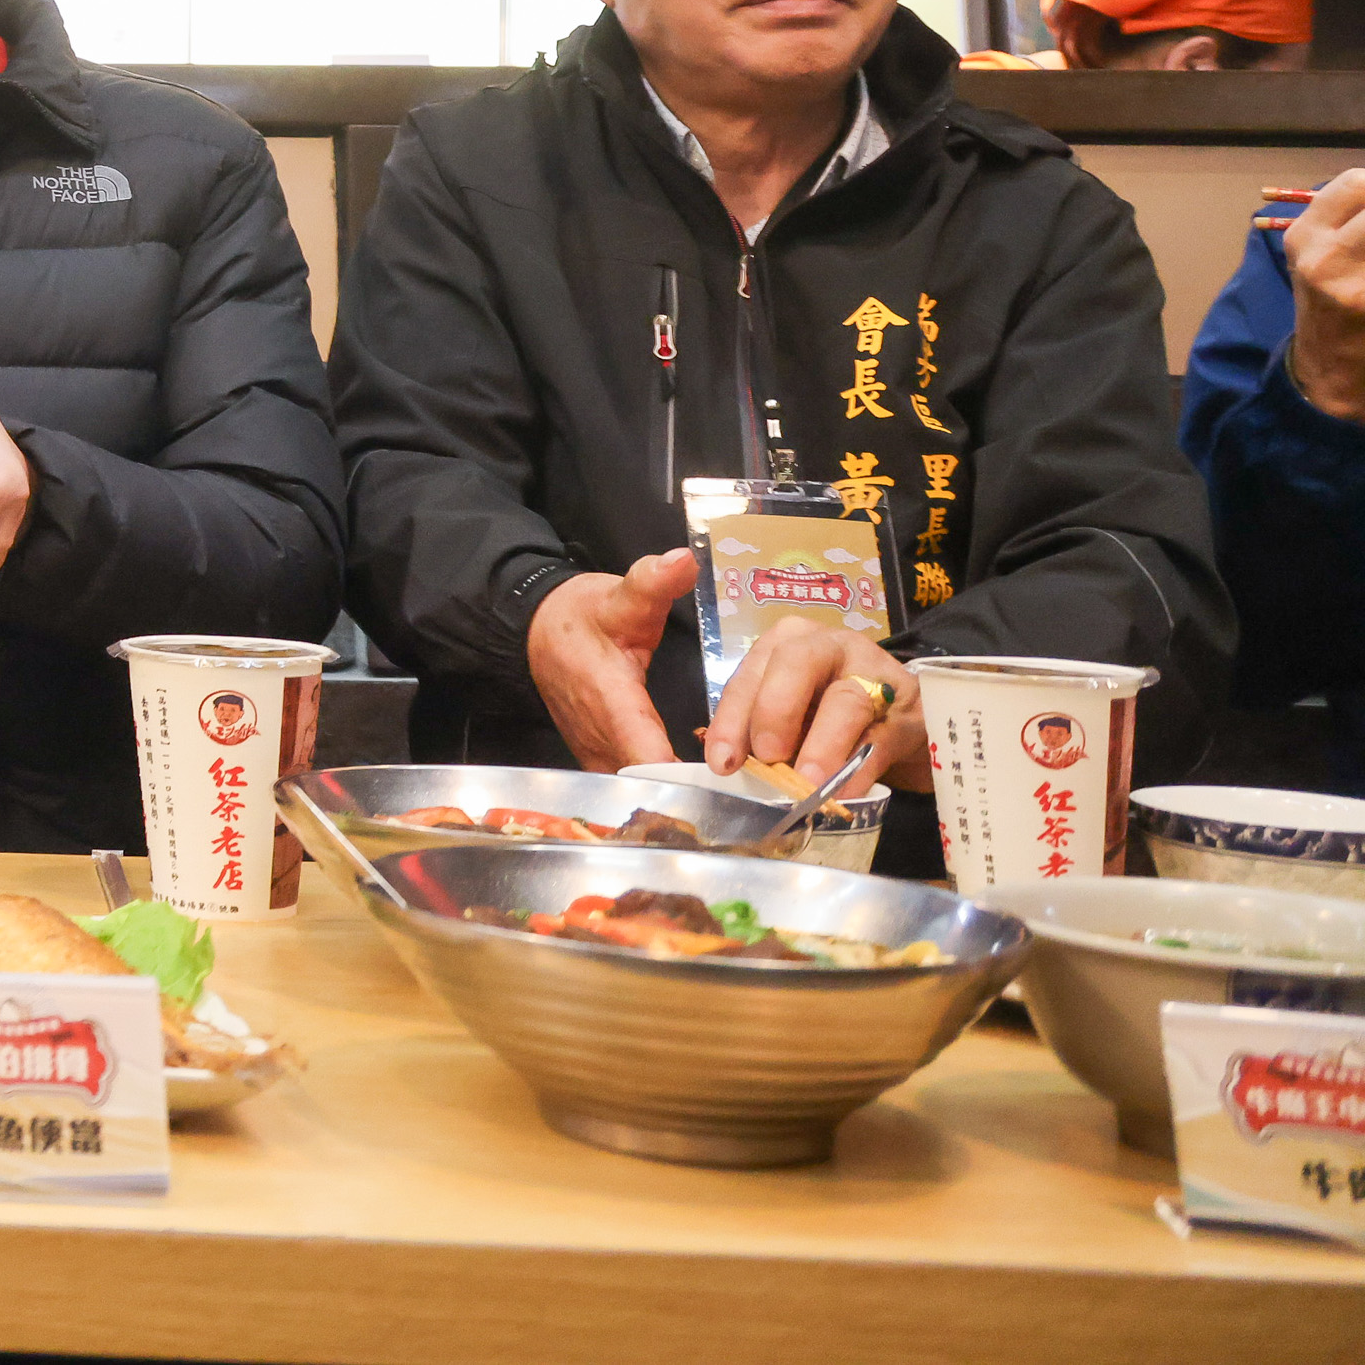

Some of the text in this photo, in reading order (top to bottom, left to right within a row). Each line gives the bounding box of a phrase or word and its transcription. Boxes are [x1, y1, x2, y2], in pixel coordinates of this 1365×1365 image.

[56, 166, 93, 178] THE
[32, 176, 97, 190] NORTH
[52, 189, 99, 204] FACE
[840, 296, 910, 420] 會長
[208, 757, 248, 890] 紅茶老店
